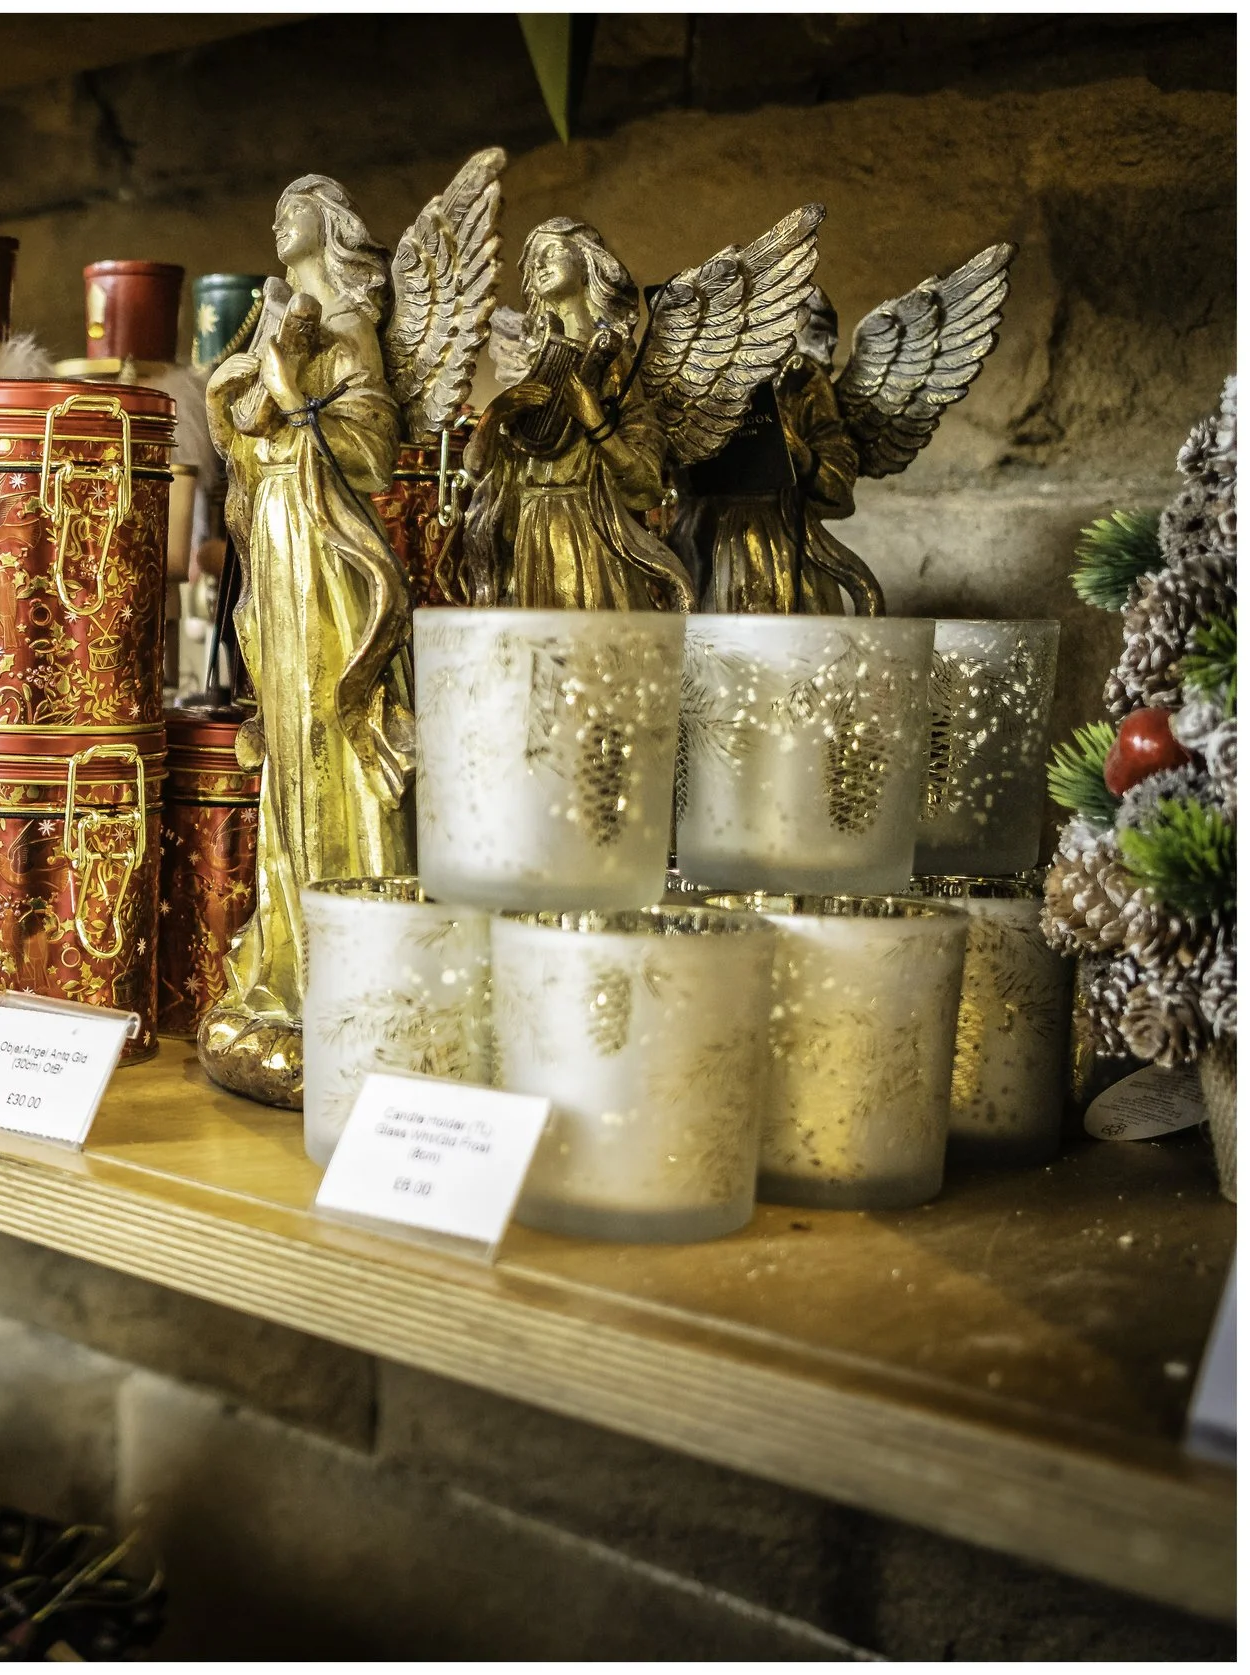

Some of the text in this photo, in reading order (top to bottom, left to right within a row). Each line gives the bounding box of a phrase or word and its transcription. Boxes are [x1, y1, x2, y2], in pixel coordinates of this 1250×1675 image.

[0, 1041, 24, 1055] Objet
[24, 1044, 48, 1059] Angel
[11, 1057, 42, 1073] (30cm)
[6, 1092, 42, 1109] £30.00
[383, 1106, 425, 1125] Candle
[426, 1114, 466, 1131] Holder
[374, 1122, 407, 1140] Glass
[458, 1136, 492, 1155] Frost
